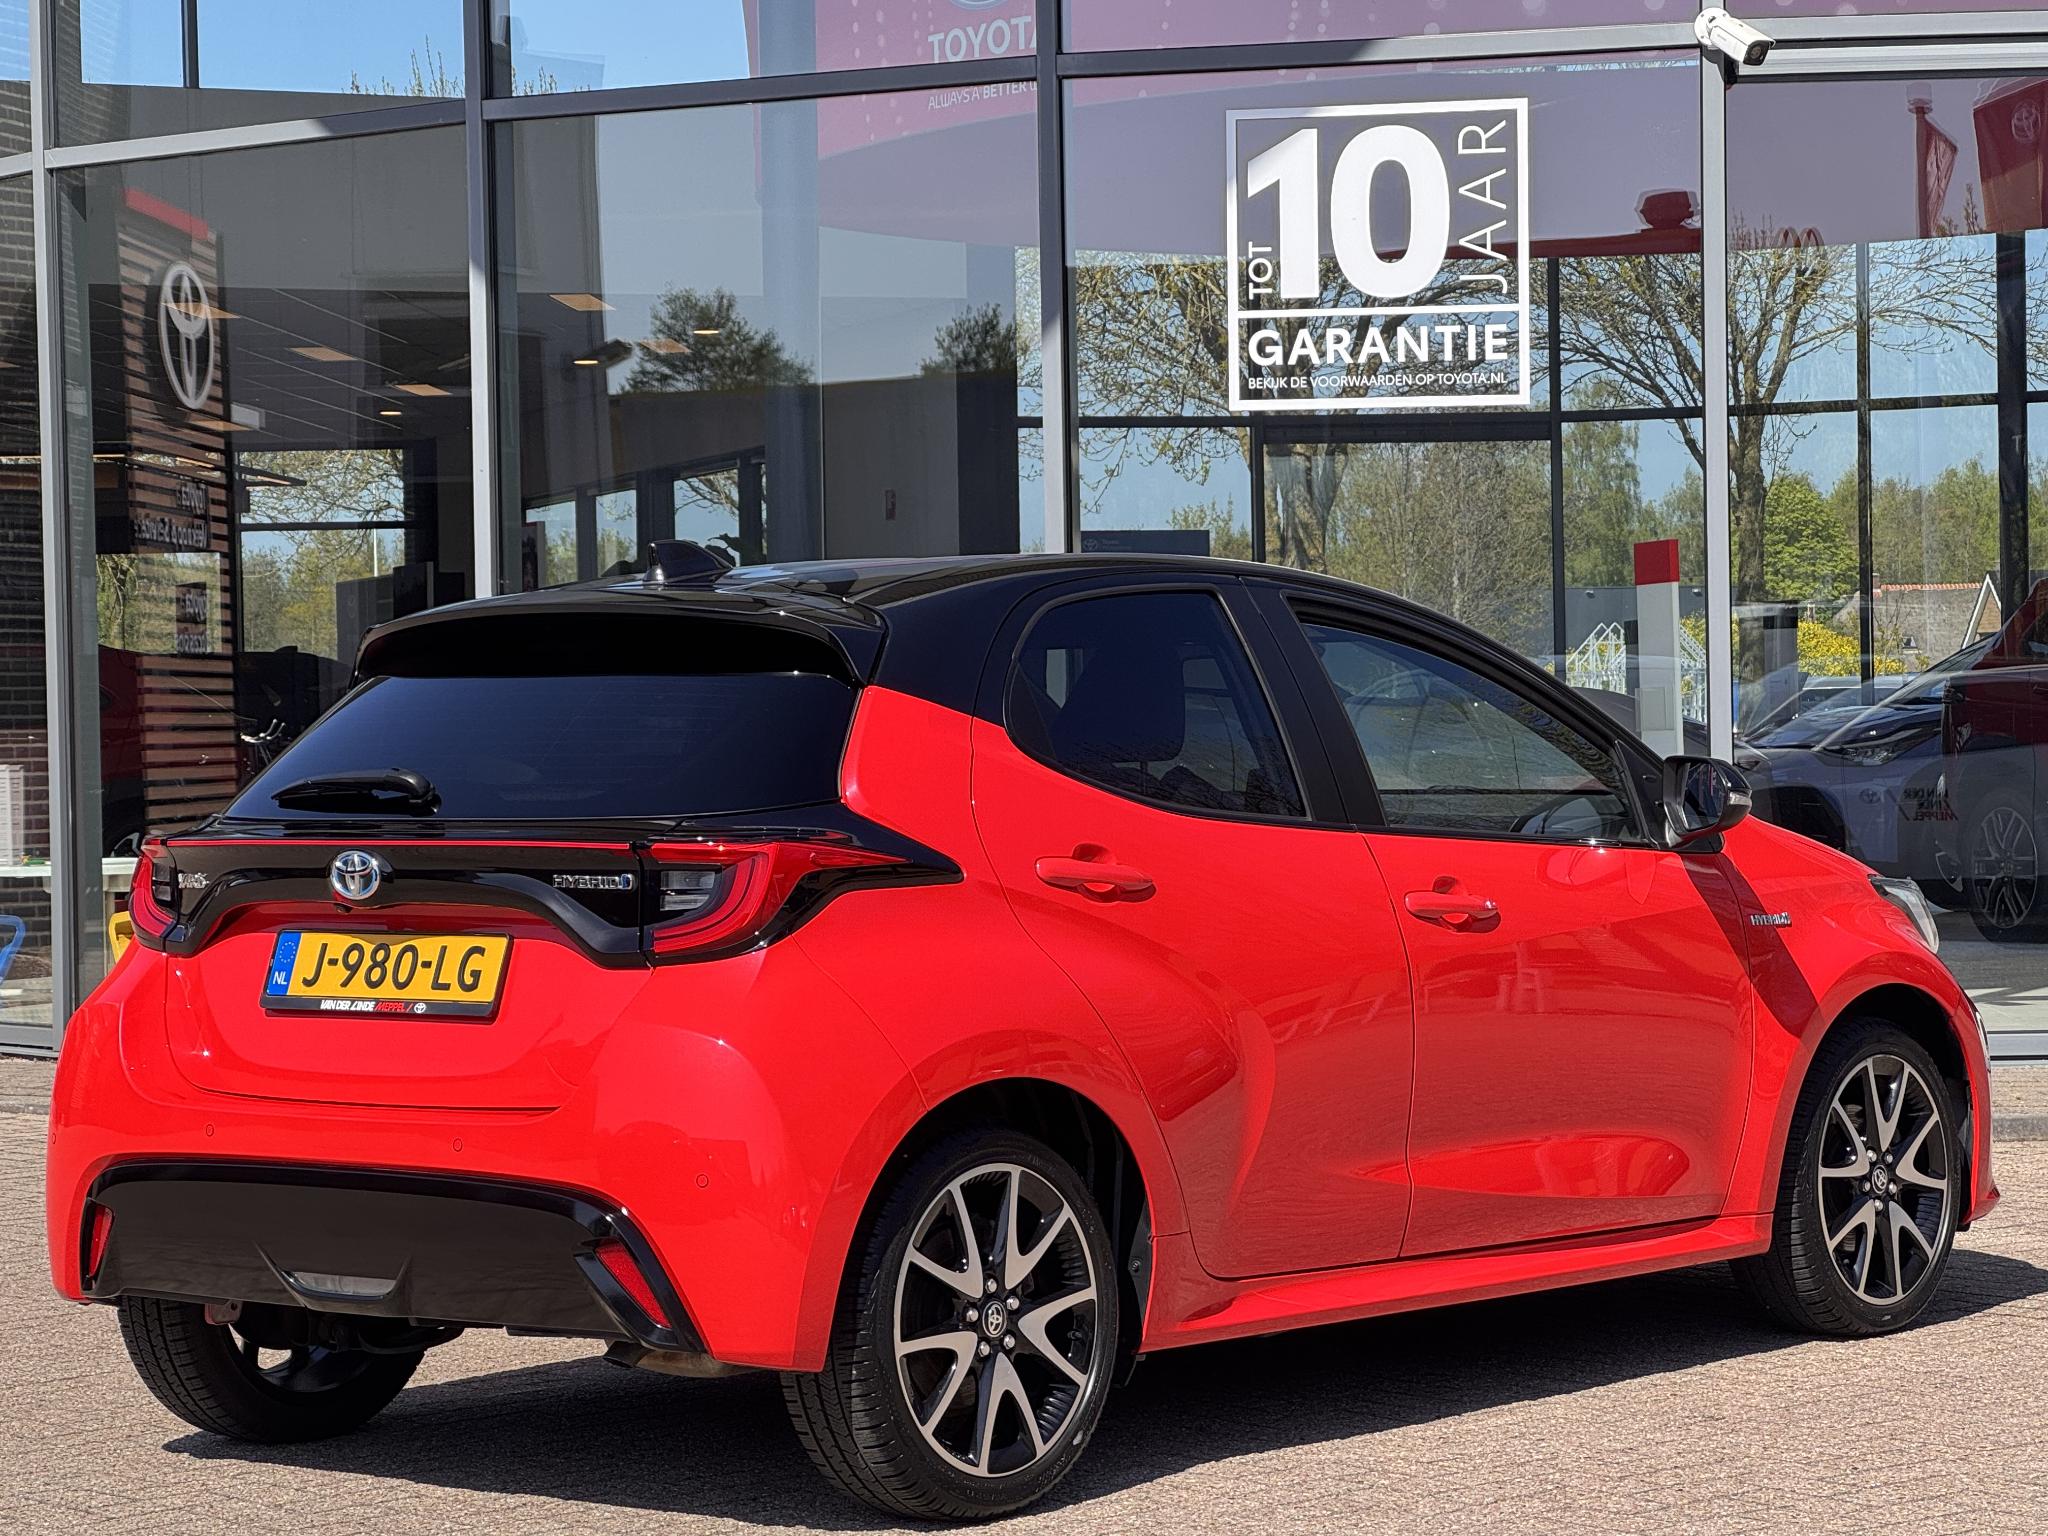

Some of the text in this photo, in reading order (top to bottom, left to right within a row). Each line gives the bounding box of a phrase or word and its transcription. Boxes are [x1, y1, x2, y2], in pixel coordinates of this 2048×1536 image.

[928, 16, 1037, 63] TOYOT
[928, 87, 970, 111] ALWAYS
[971, 86, 981, 101] A
[982, 81, 1028, 99] BETTER
[1247, 124, 1450, 299] 10
[1458, 119, 1507, 294] JAAR
[1248, 241, 1272, 299] TOT
[1248, 323, 1509, 366] GARANTIE
[1248, 372, 1508, 390] BEKIJK DE VOORWAARDEN OP TOYOTA.NL
[273, 971, 288, 986] NL
[302, 942, 487, 993] J-980-LG
[375, 1002, 405, 1013] MEPPEL
